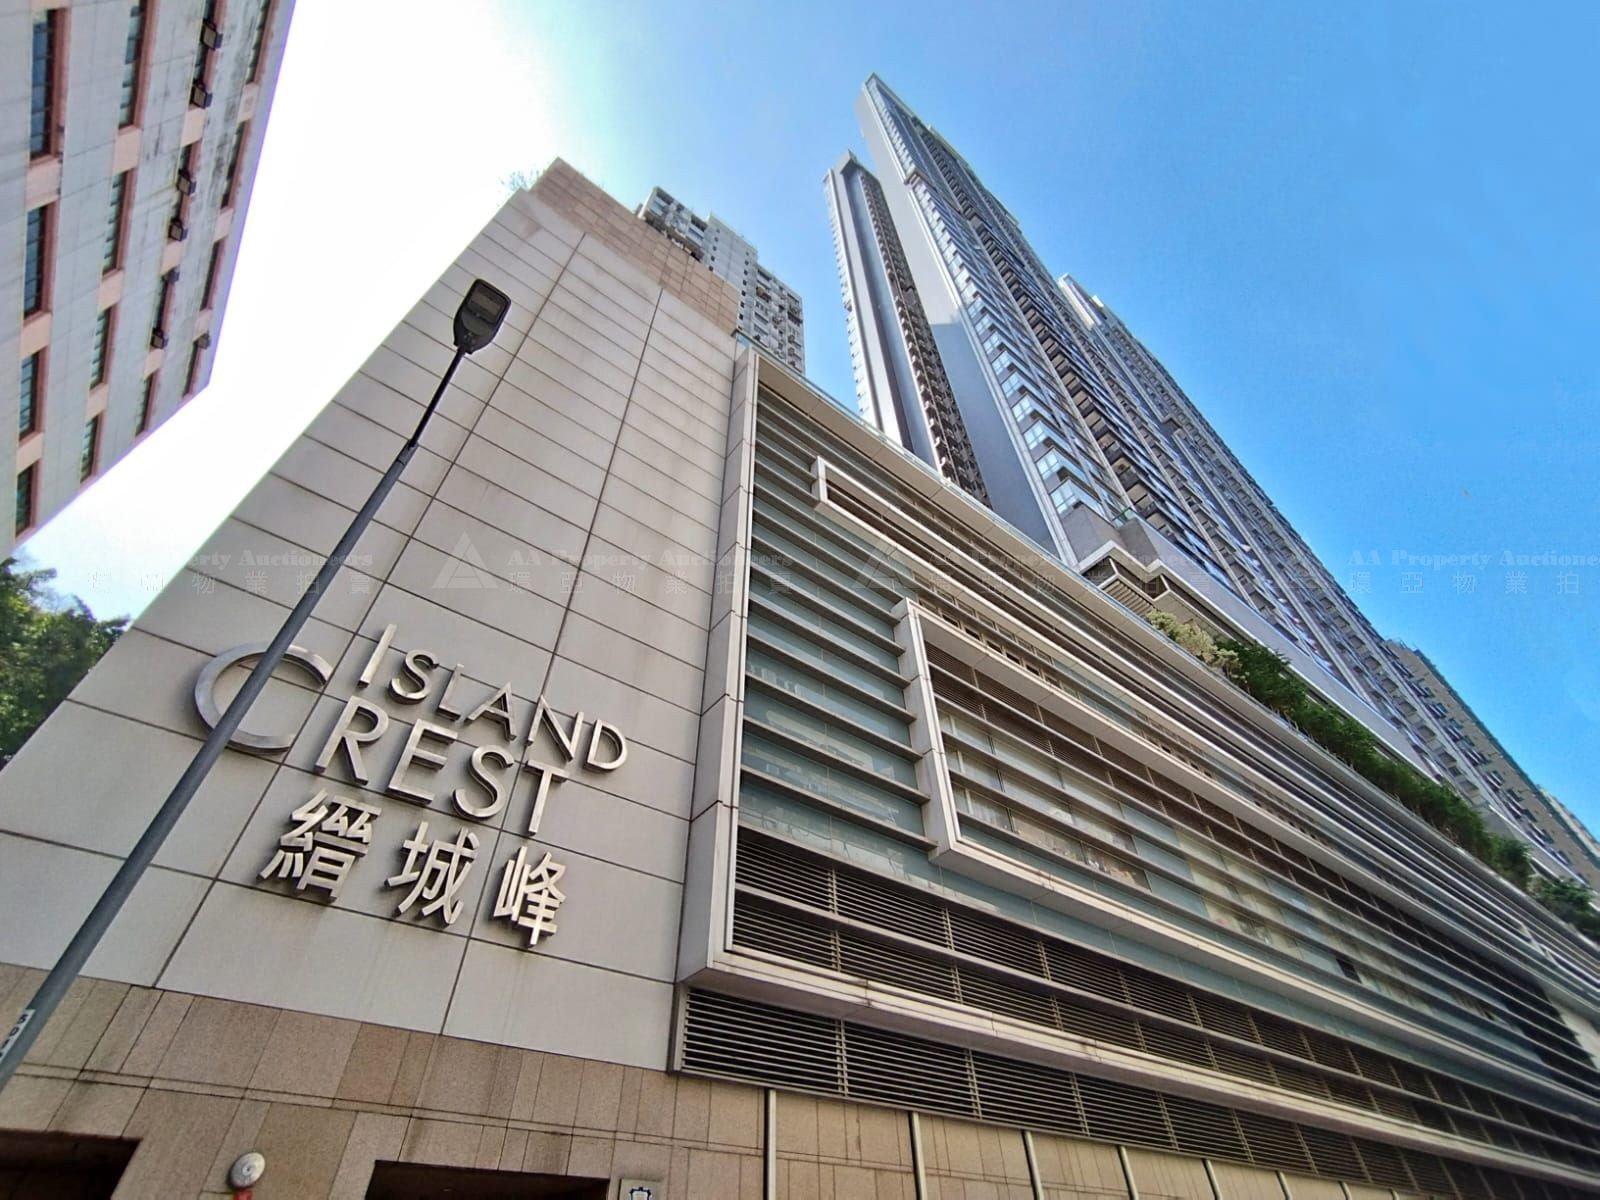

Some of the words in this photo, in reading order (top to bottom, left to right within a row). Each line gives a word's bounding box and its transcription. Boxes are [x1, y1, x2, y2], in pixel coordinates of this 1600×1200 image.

[194, 641, 570, 837] CREST
[358, 623, 629, 772] ISLAND
[0, 1013, 29, 1058] 501
